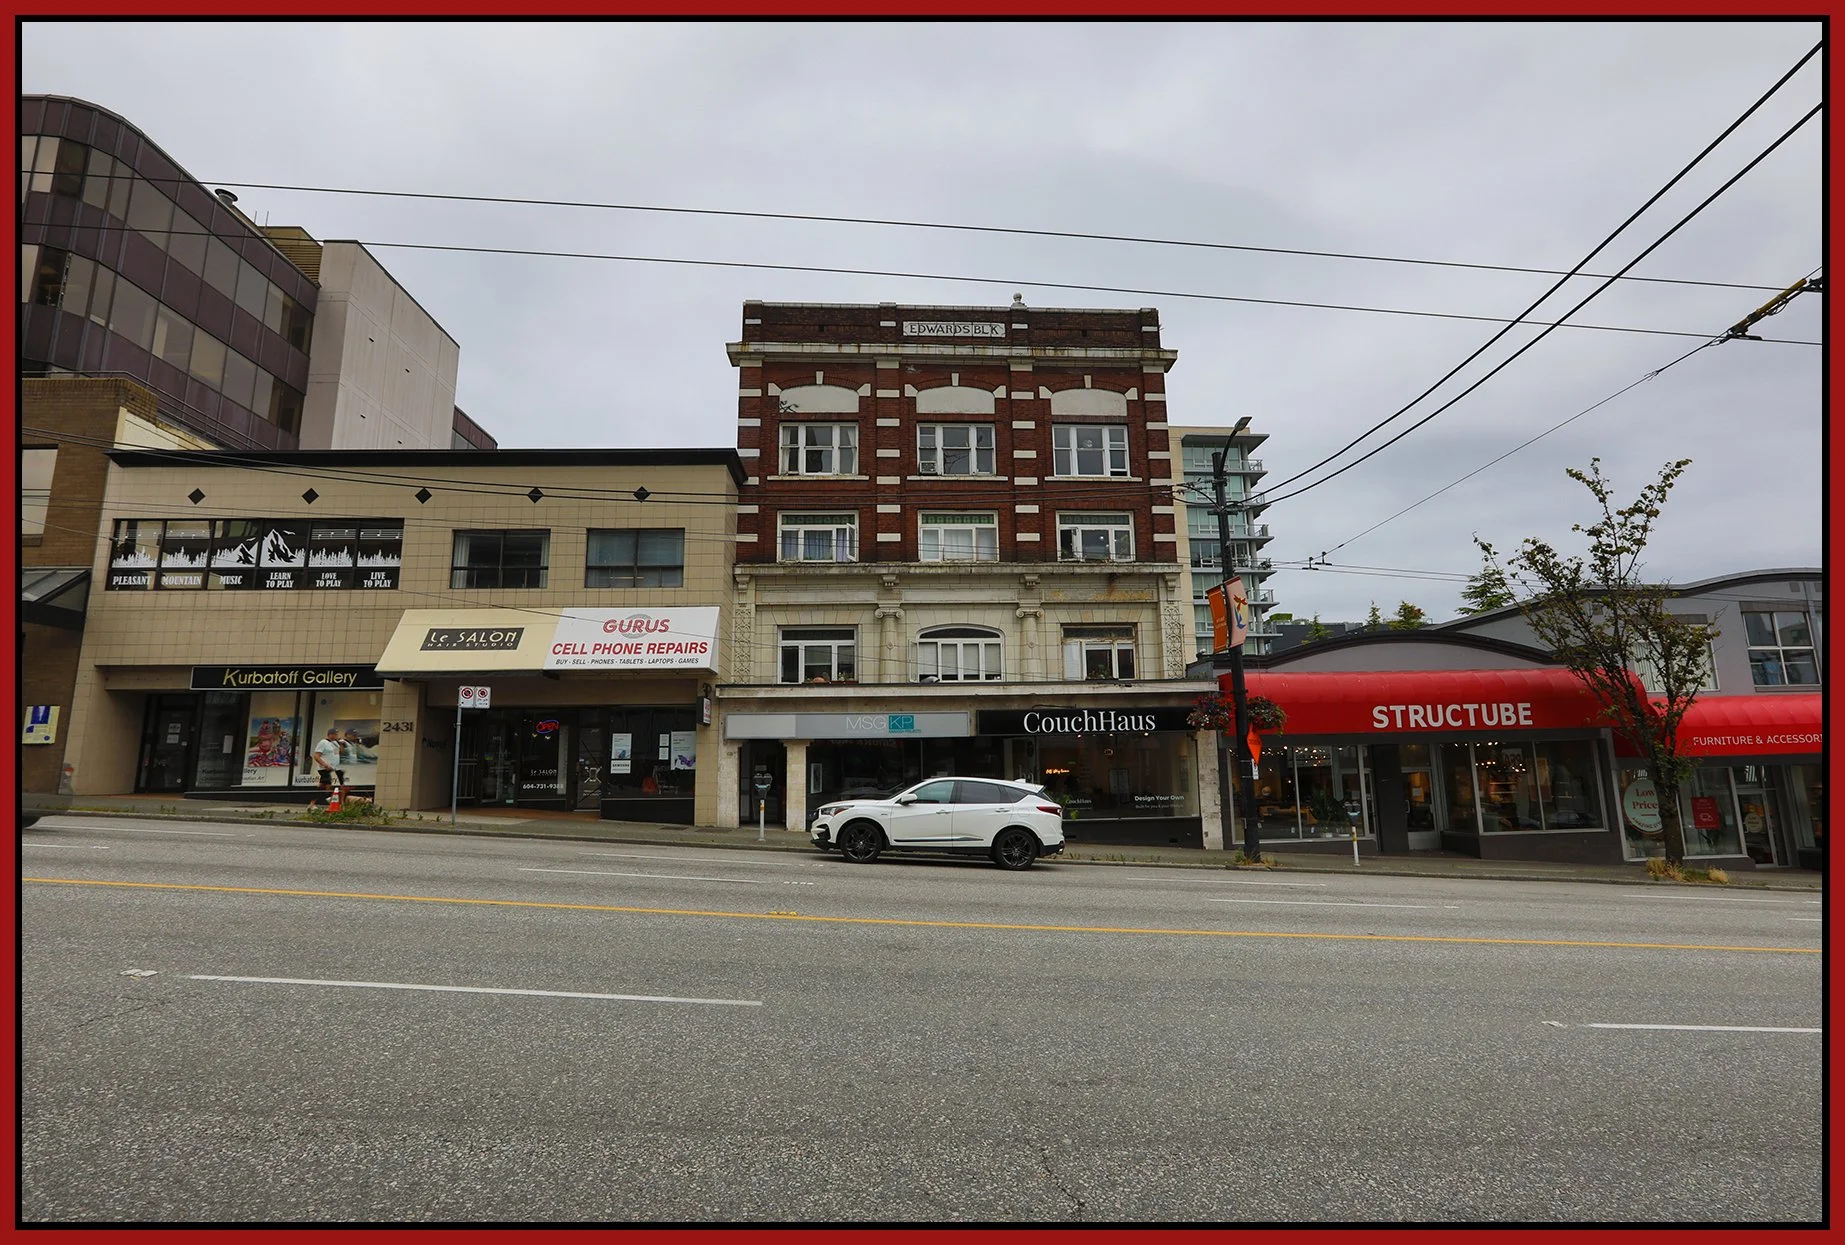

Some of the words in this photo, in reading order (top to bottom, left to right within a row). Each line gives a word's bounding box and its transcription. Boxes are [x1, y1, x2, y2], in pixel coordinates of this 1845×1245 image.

[910, 324, 970, 334] EDWARDS
[973, 324, 999, 335] BLK
[112, 575, 152, 586] PLEASANT
[162, 575, 201, 586] MOUNTAIN
[220, 575, 243, 585] MUSIC
[270, 572, 292, 580] LEARN
[321, 572, 337, 580] LOVE
[370, 571, 386, 580] LIVE
[266, 580, 275, 588] TO
[276, 580, 295, 588] PLAY
[316, 580, 325, 588] TO
[325, 580, 342, 588] PLAY
[363, 580, 373, 588] TO
[374, 580, 392, 588] PLAY
[602, 618, 670, 633] GURUS
[430, 631, 449, 643] Le
[456, 631, 518, 643] SALON
[552, 643, 587, 655] CELL
[592, 642, 643, 655] PHONE
[646, 641, 708, 654] REPAIRS
[223, 668, 299, 687] Kurbatoff
[302, 670, 357, 688] Gallery
[1372, 702, 1533, 728] STRUCTUBE
[383, 721, 413, 732] 2431
[846, 716, 887, 730] MSG
[889, 716, 913, 730] KP
[1023, 710, 1156, 734] CouchHaus
[1693, 736, 1753, 746] FURNITURE
[1755, 736, 1763, 745] &
